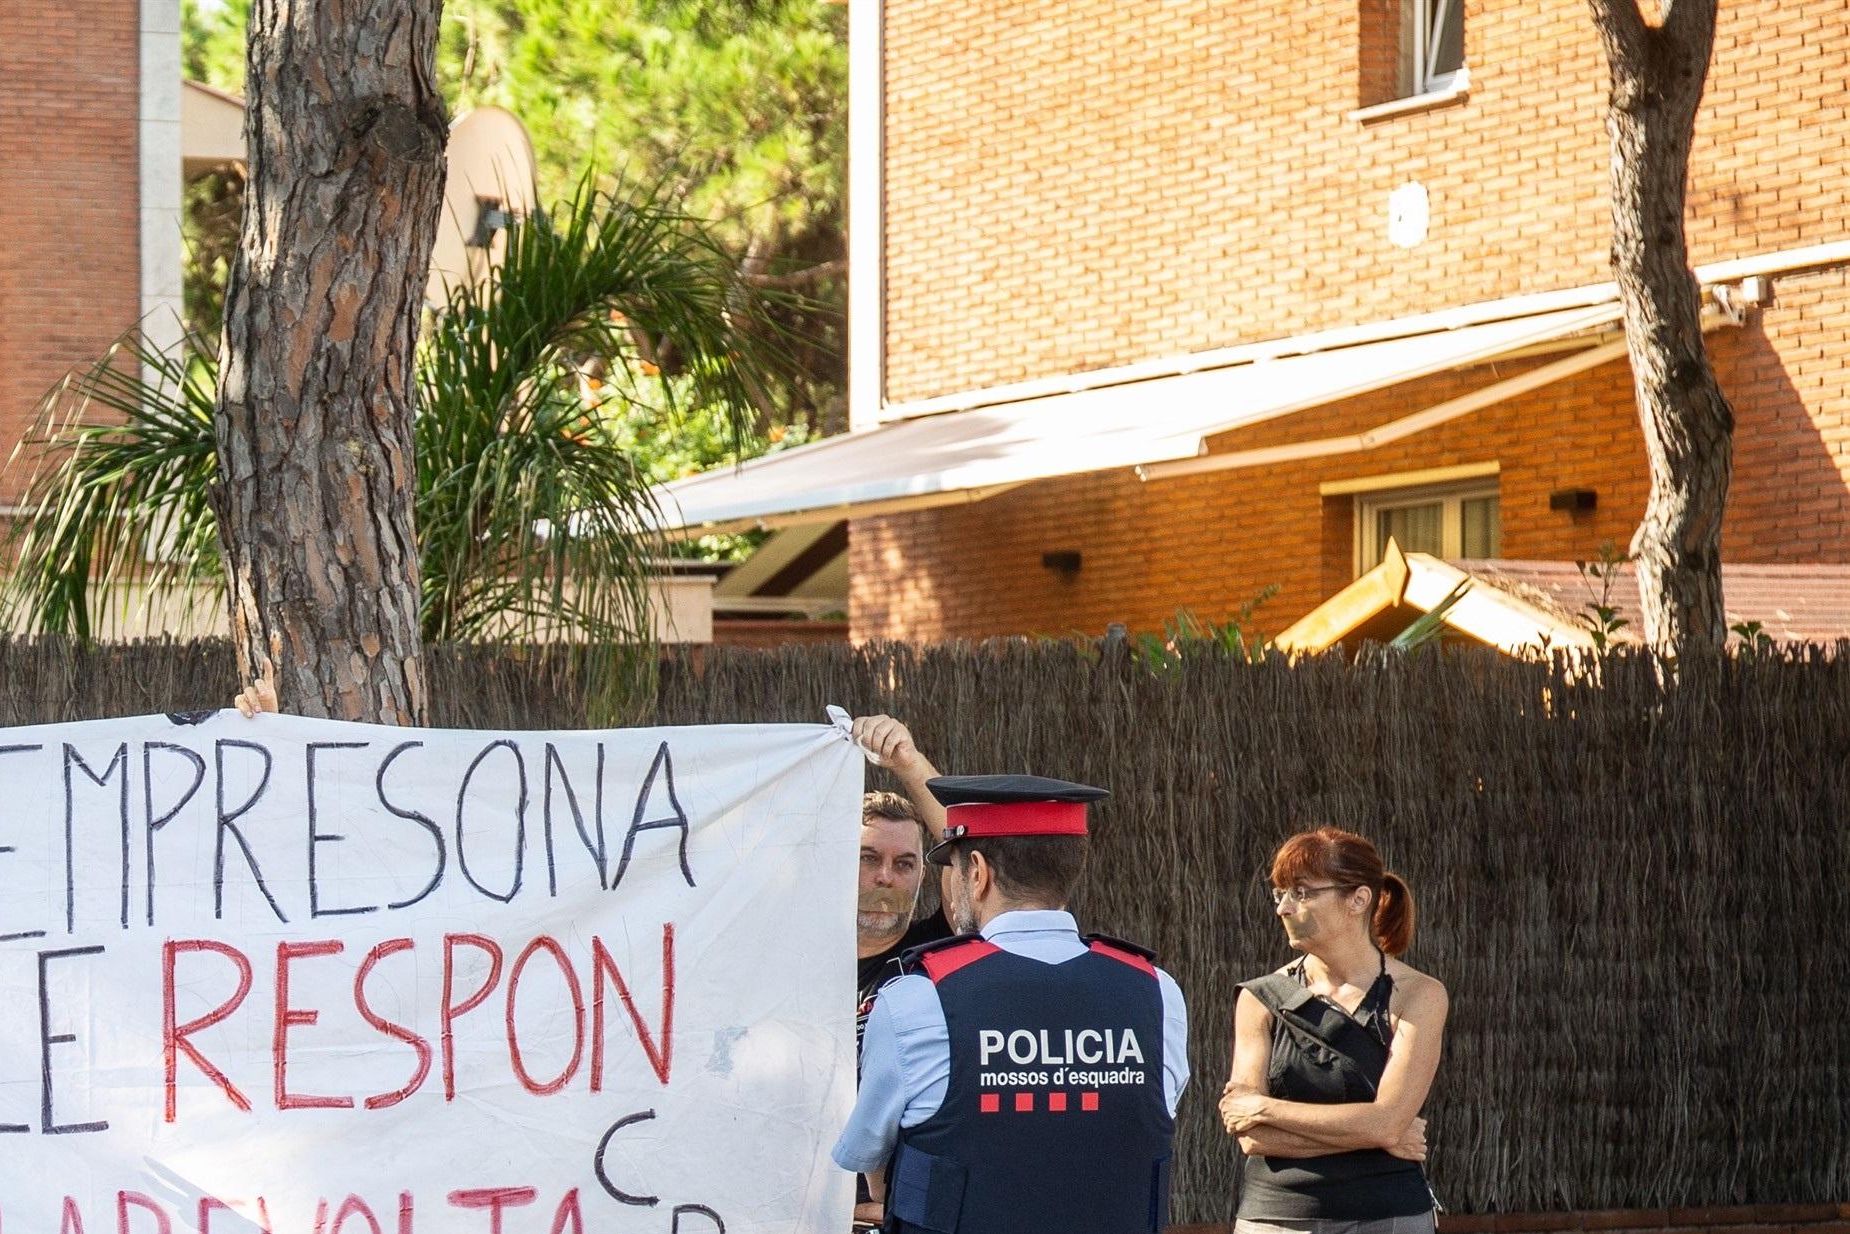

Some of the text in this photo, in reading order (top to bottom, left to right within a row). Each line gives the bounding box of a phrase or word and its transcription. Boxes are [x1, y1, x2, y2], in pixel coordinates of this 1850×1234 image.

[161, 922, 677, 1124] RESPON
[979, 1028, 1145, 1065] POLICIA
[980, 1071, 1049, 1086] mossos
